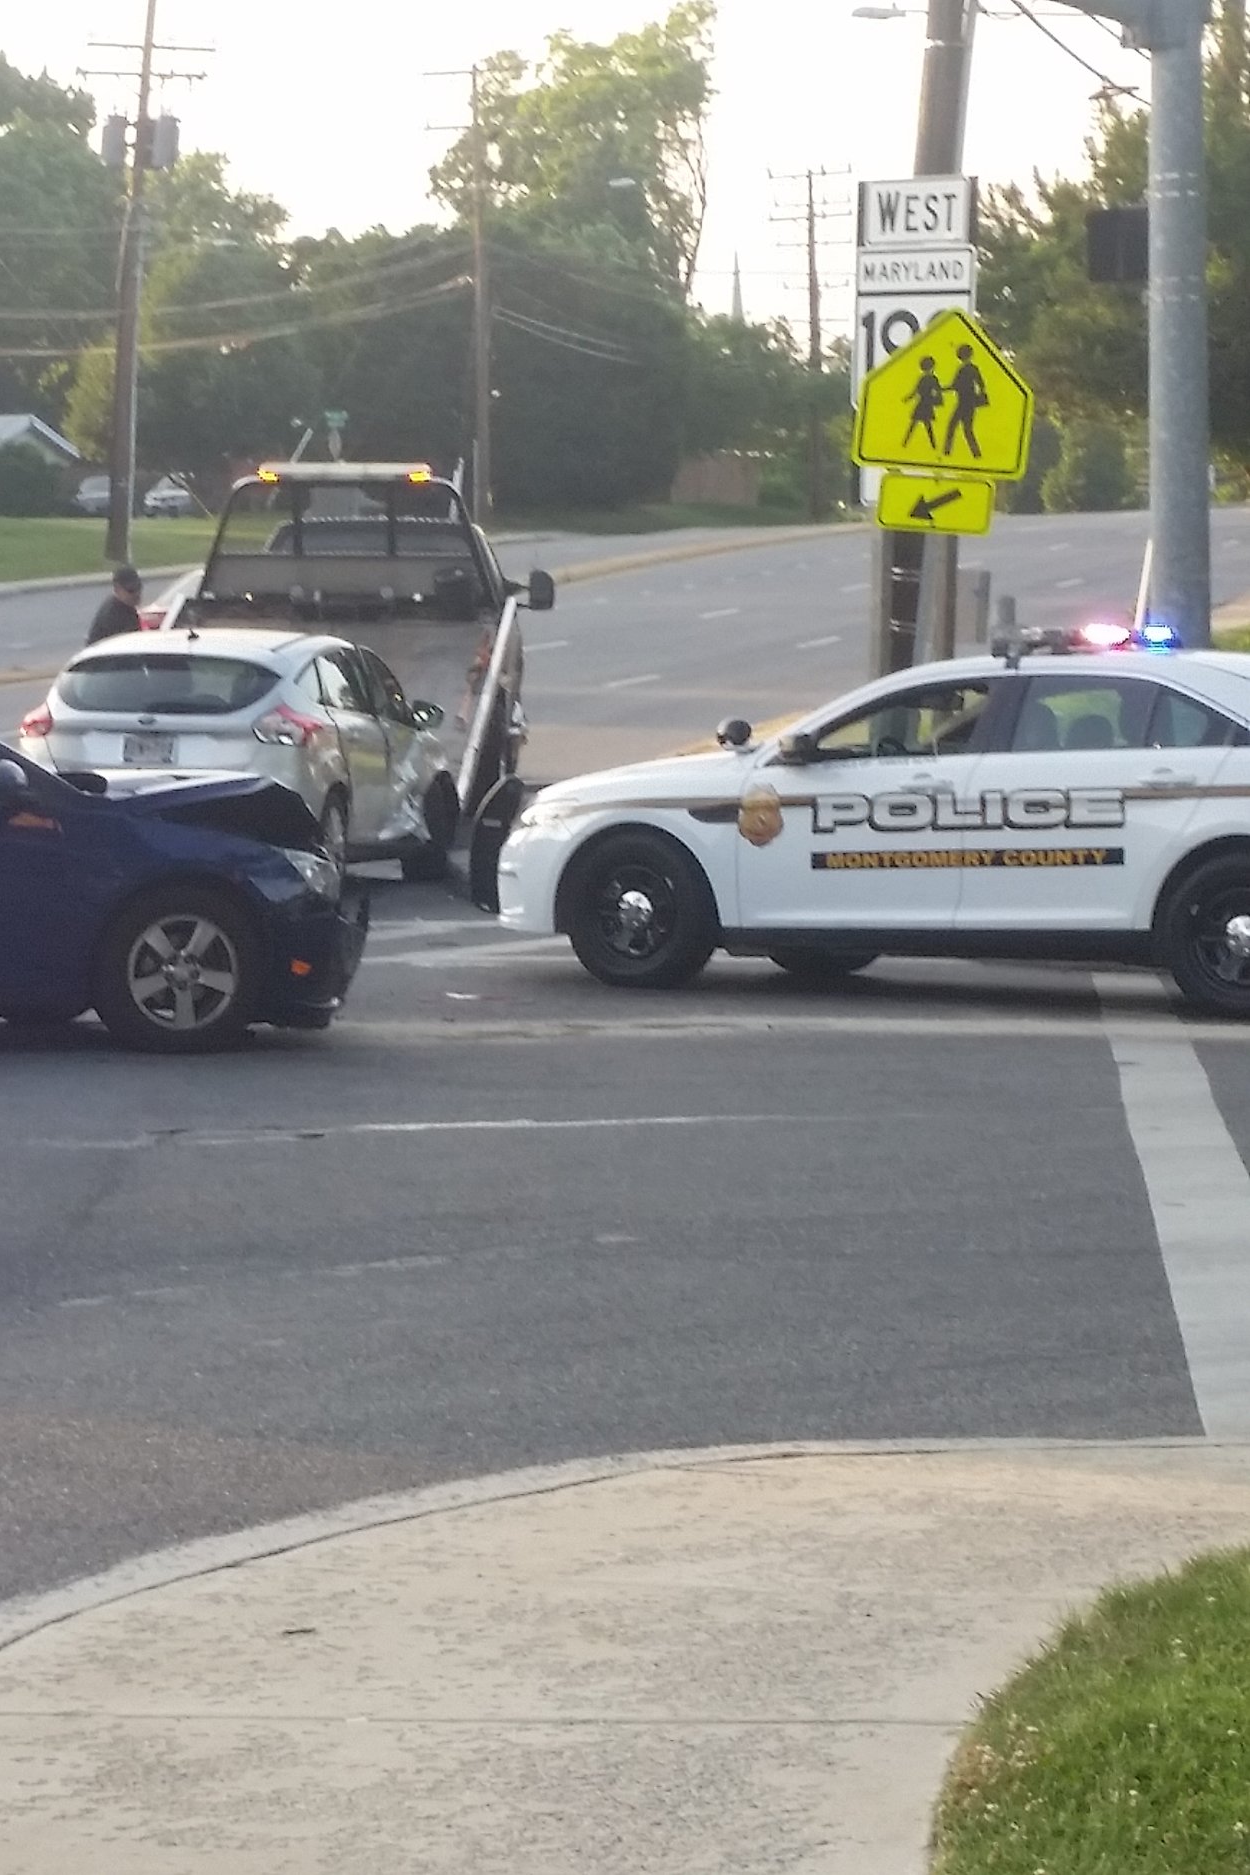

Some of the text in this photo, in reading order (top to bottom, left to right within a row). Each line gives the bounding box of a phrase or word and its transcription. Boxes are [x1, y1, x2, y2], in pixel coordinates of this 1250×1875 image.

[878, 191, 957, 232] WEST
[864, 260, 963, 281] MARYLAND
[812, 788, 1125, 833] POLICE
[827, 850, 1105, 868] MONTGOMERY COUNTY
